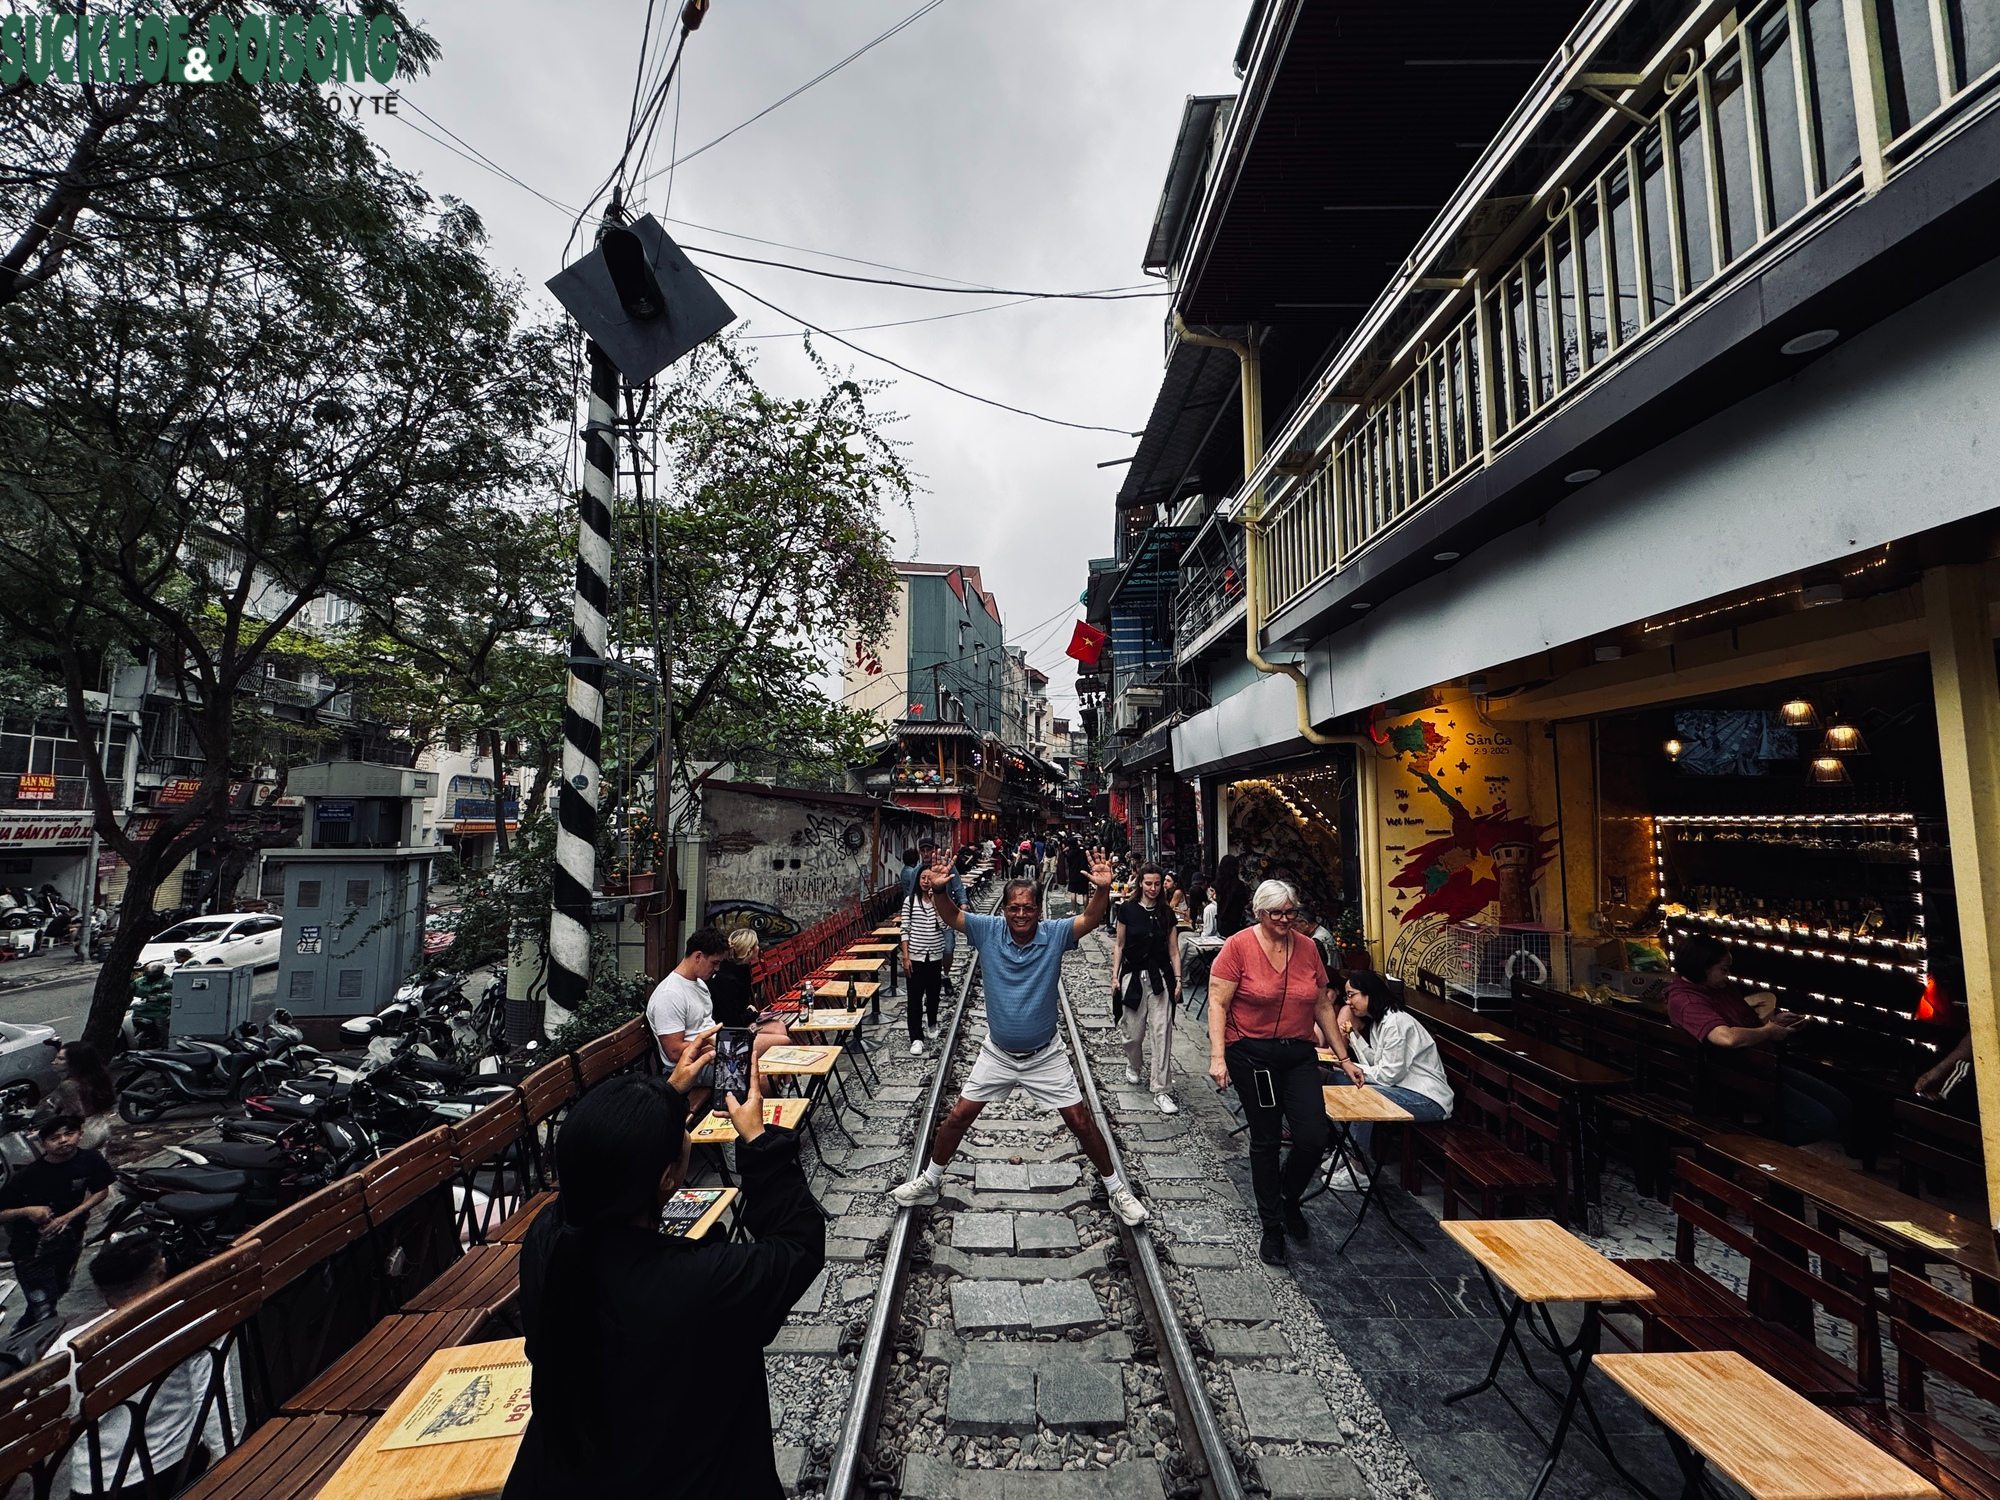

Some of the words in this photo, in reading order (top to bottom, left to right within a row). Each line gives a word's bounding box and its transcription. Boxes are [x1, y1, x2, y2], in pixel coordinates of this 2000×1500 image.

[1466, 733, 1492, 745] Sân
[1494, 733, 1512, 745] Ga
[13, 824, 42, 840] BÁN
[41, 824, 61, 840] KÝ
